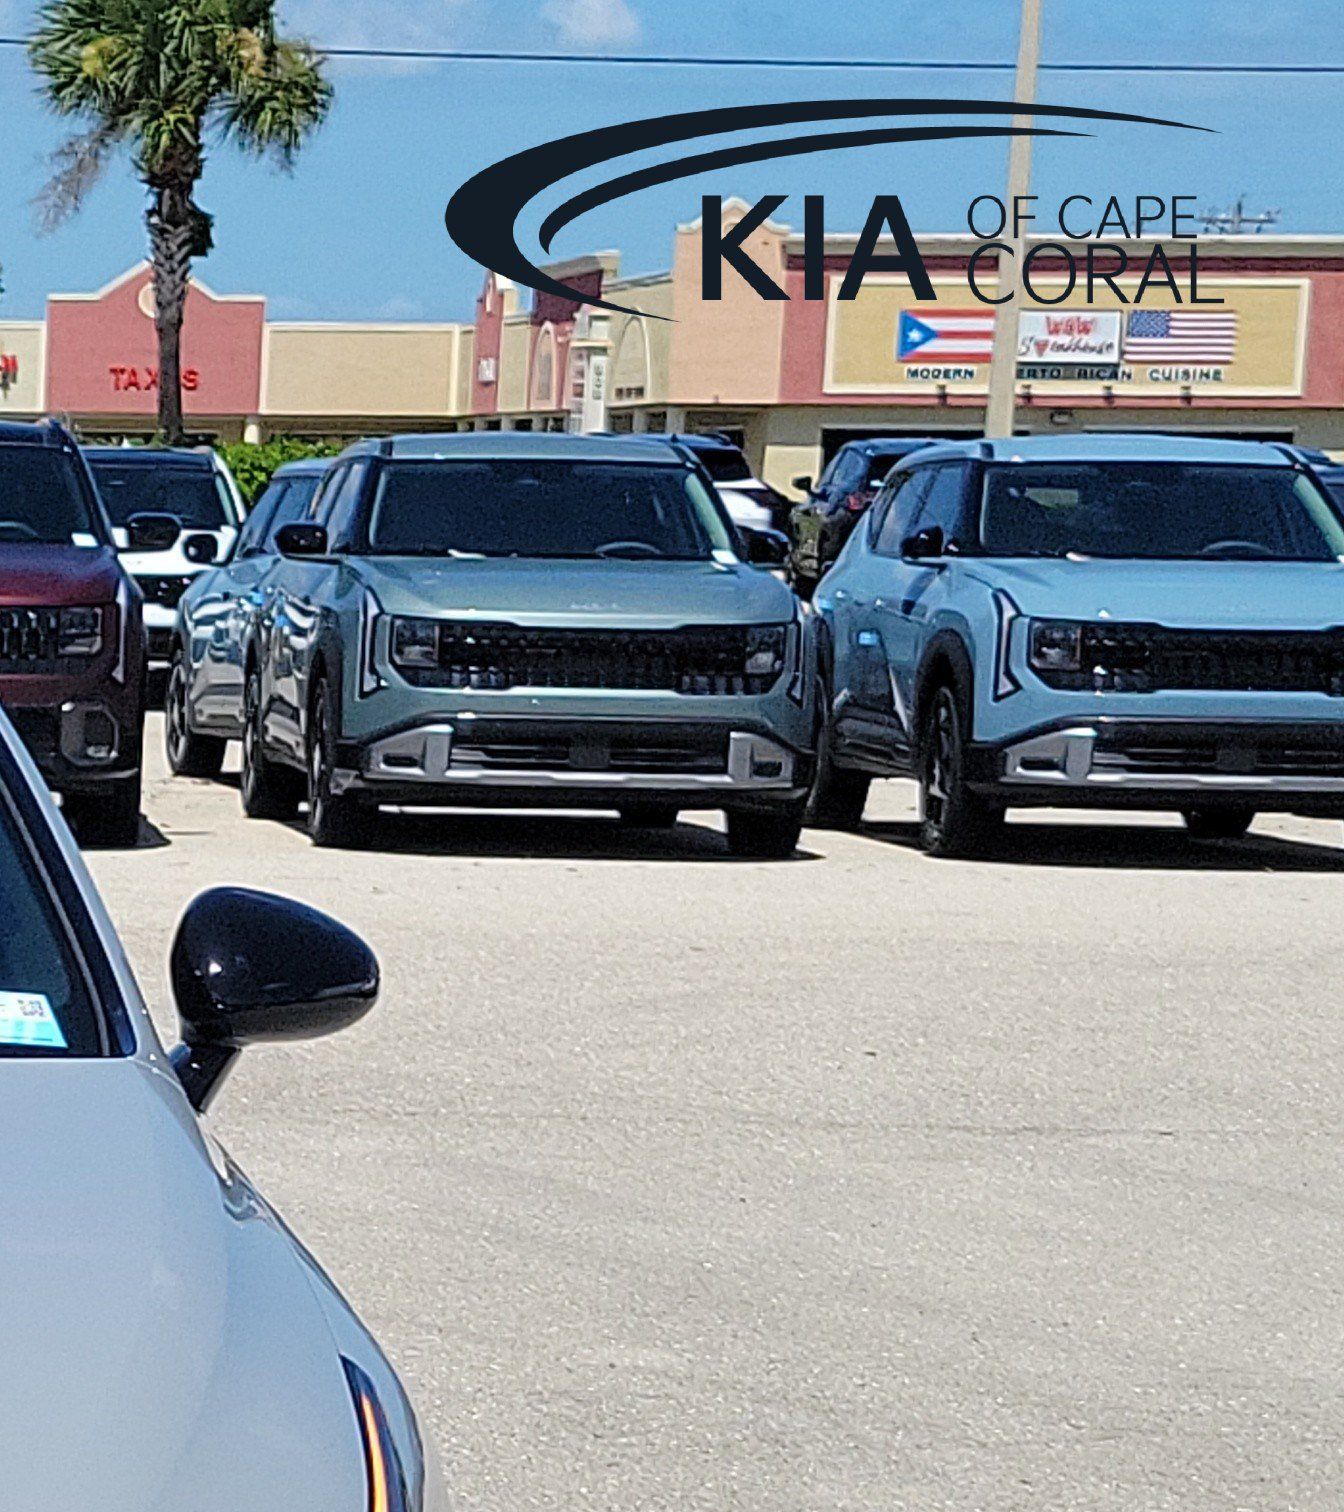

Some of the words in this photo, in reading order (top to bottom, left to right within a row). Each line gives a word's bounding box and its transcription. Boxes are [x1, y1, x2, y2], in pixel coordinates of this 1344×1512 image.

[109, 365, 199, 391] TAXS
[906, 367, 975, 379] MODERN
[1015, 367, 1062, 380] ERTO
[1148, 367, 1223, 382] CUISINE
